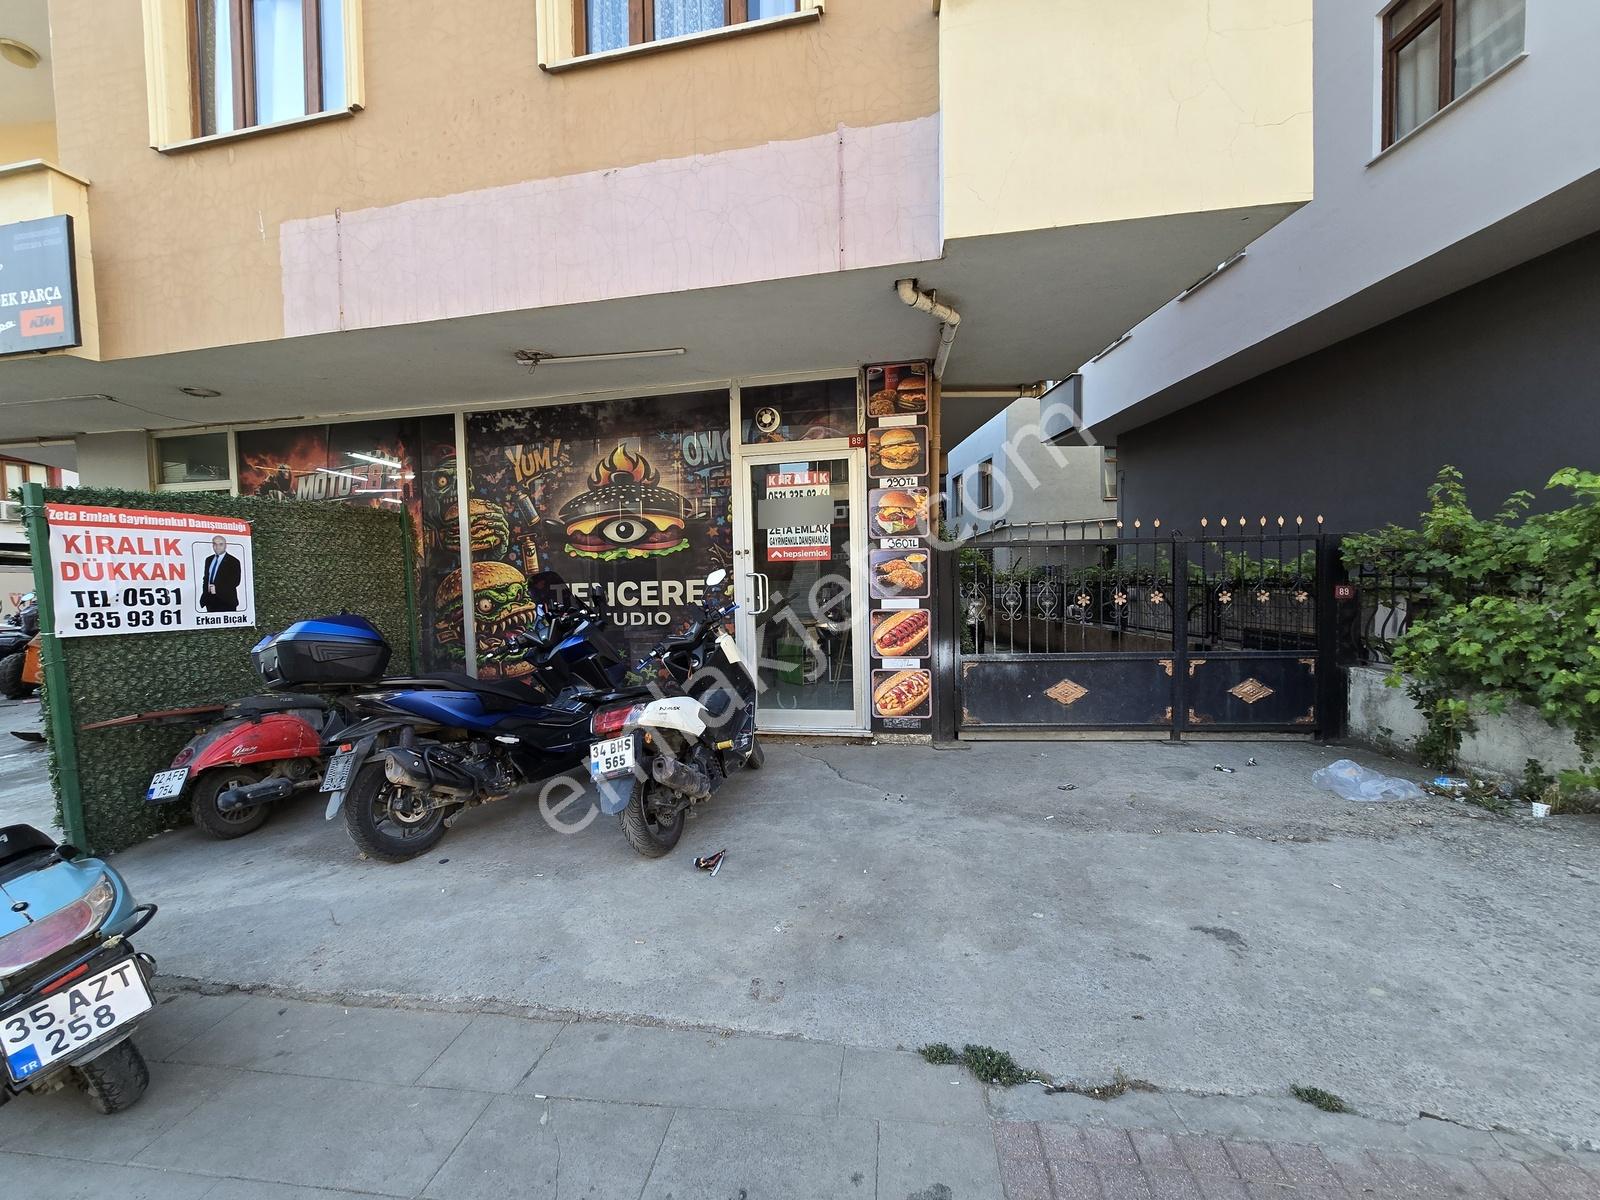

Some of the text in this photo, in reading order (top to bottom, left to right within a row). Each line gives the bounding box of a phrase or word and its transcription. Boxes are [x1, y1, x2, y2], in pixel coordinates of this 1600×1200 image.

[20, 286, 62, 305] PARÇA
[505, 438, 561, 482] YUM!
[48, 509, 247, 532] Zeta Emlak Gayrimenkul Danışmanlığı
[795, 524, 829, 534] EMLAK
[62, 531, 183, 556] KİRALIK
[783, 549, 828, 559] hepsiemlak
[60, 558, 186, 581] DÜKKAN
[1339, 587, 1350, 596] 89
[74, 609, 182, 630] 335 93 61
[196, 615, 248, 626] Erkan Bıçak
[592, 739, 631, 758] 34 BHS
[605, 755, 626, 770] 565
[153, 774, 165, 785] 22
[5, 964, 130, 1043] 35 AZT
[45, 1004, 116, 1056] 258
[20, 1060, 39, 1074] TR
